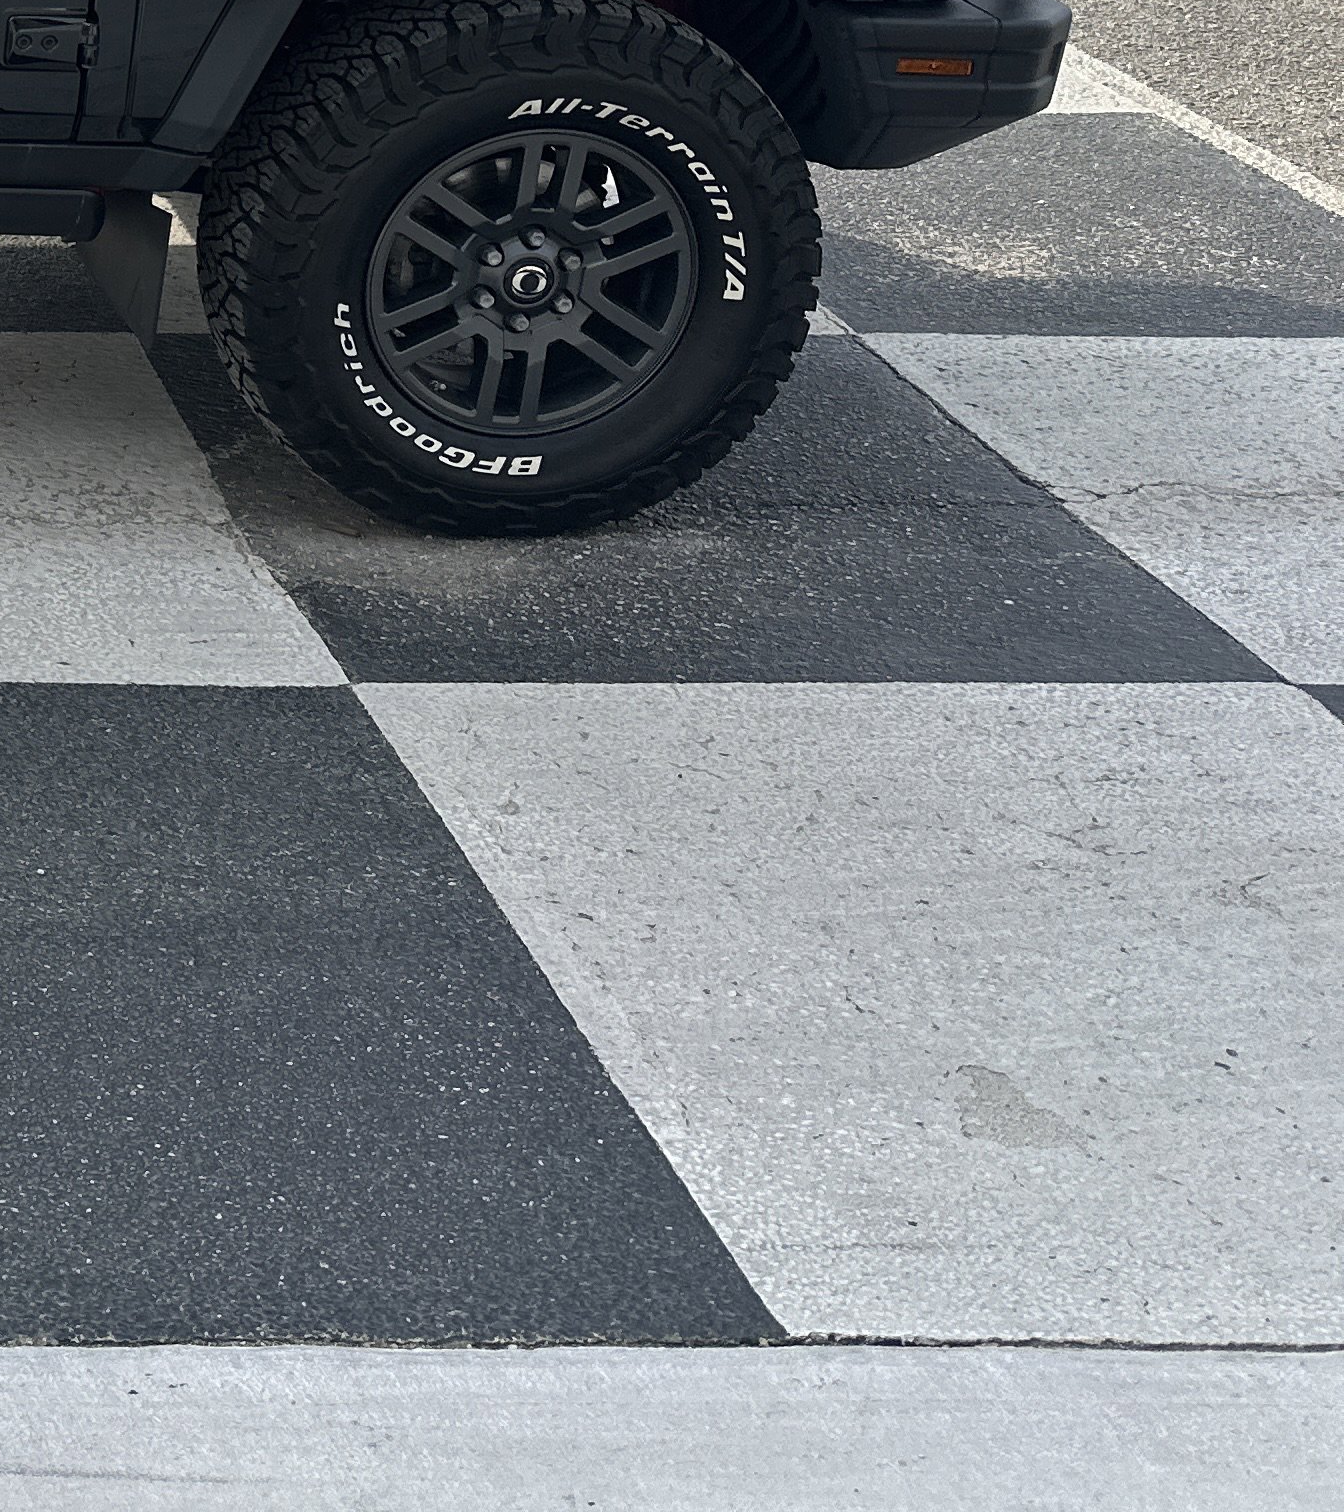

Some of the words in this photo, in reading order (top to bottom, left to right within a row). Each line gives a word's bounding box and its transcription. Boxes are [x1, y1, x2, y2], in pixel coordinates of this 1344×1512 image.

[507, 97, 735, 221] All-Terrain
[722, 230, 747, 302] T/A
[332, 302, 543, 477] BFGoodrich
